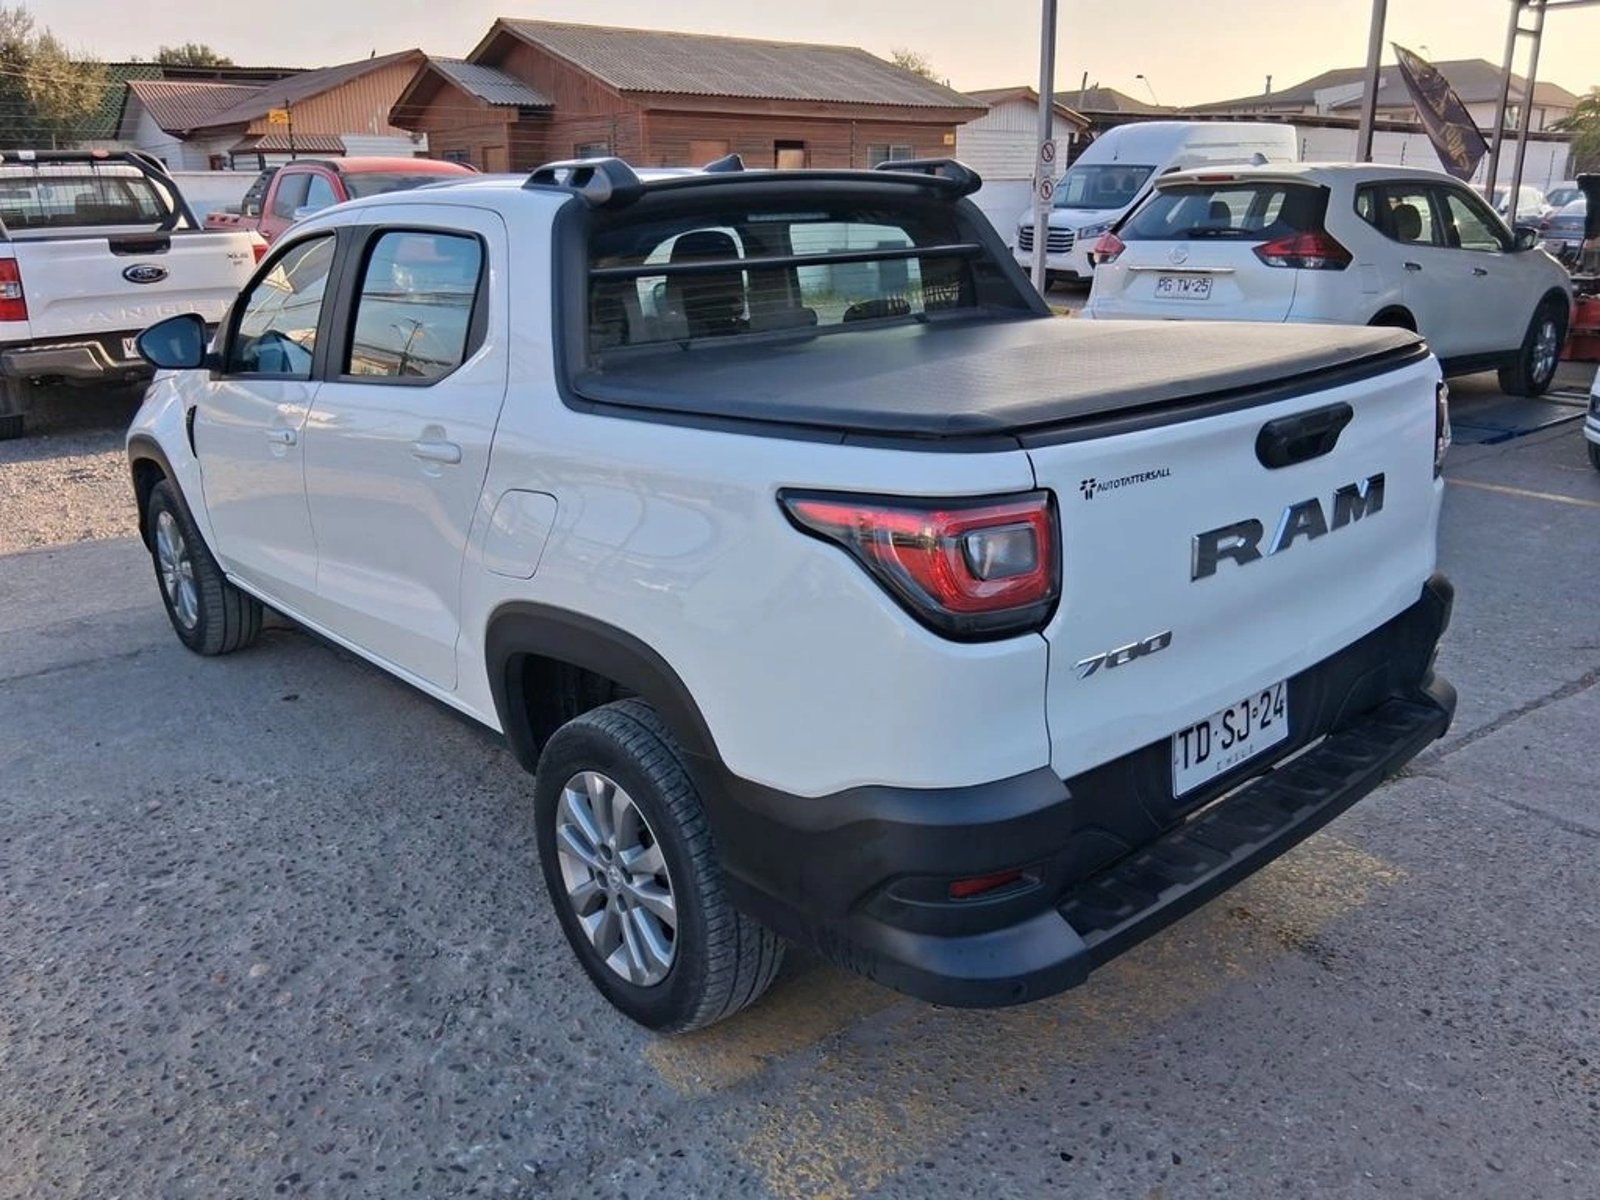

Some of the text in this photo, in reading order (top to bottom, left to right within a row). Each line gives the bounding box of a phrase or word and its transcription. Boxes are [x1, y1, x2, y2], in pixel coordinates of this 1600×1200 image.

[1097, 468, 1170, 492] AUTOTATTERSALL
[1190, 472, 1385, 582] RAM
[1074, 631, 1172, 679] 700
